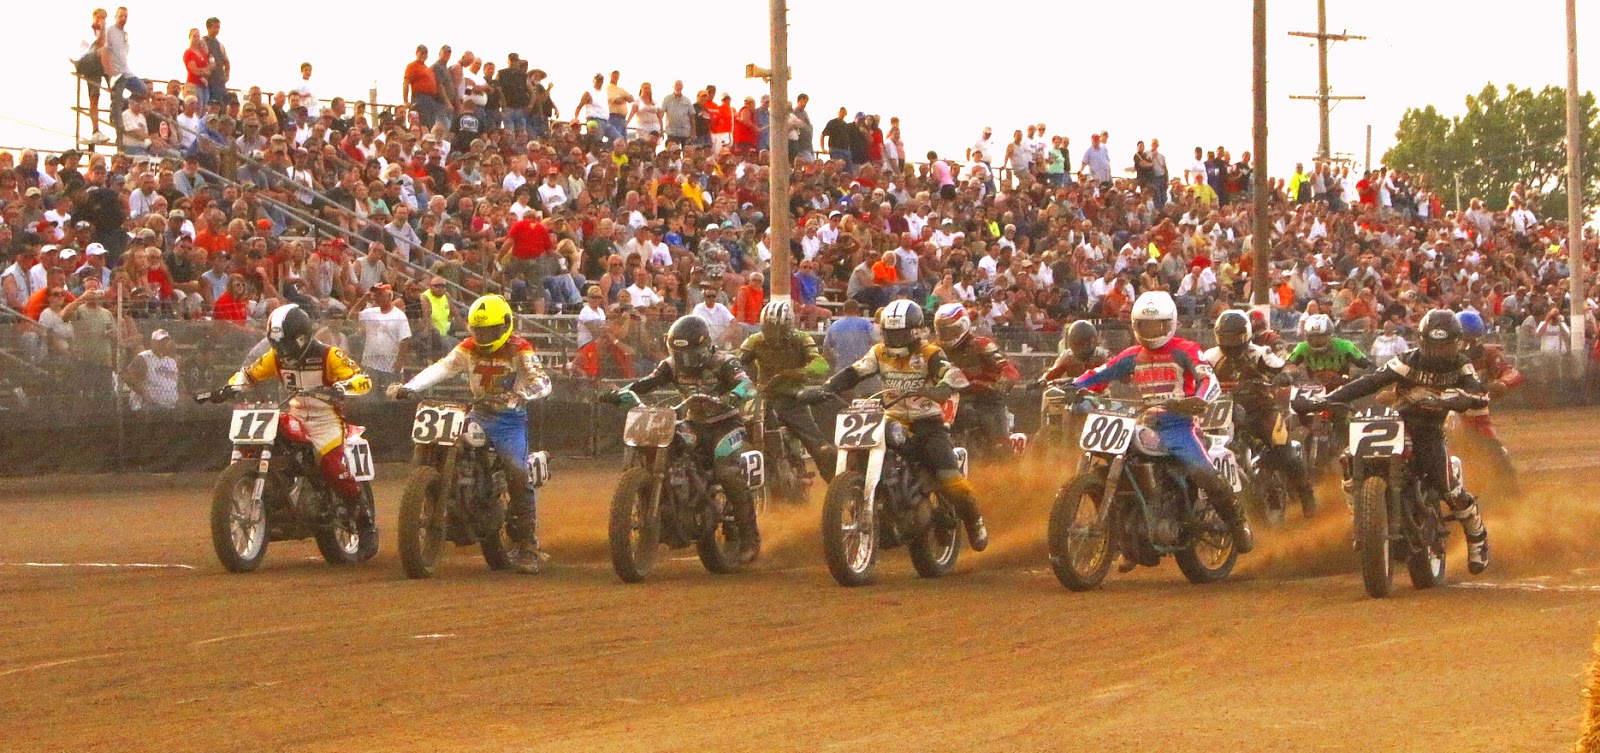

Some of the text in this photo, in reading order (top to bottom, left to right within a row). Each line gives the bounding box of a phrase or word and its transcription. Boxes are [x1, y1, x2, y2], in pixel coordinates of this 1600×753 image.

[885, 380, 924, 390] SHADES
[234, 412, 275, 439] 17
[414, 409, 463, 441] 31J
[840, 414, 884, 446] 27
[1082, 416, 1130, 451] 80B
[1356, 421, 1400, 457] 2
[351, 444, 372, 477] 17
